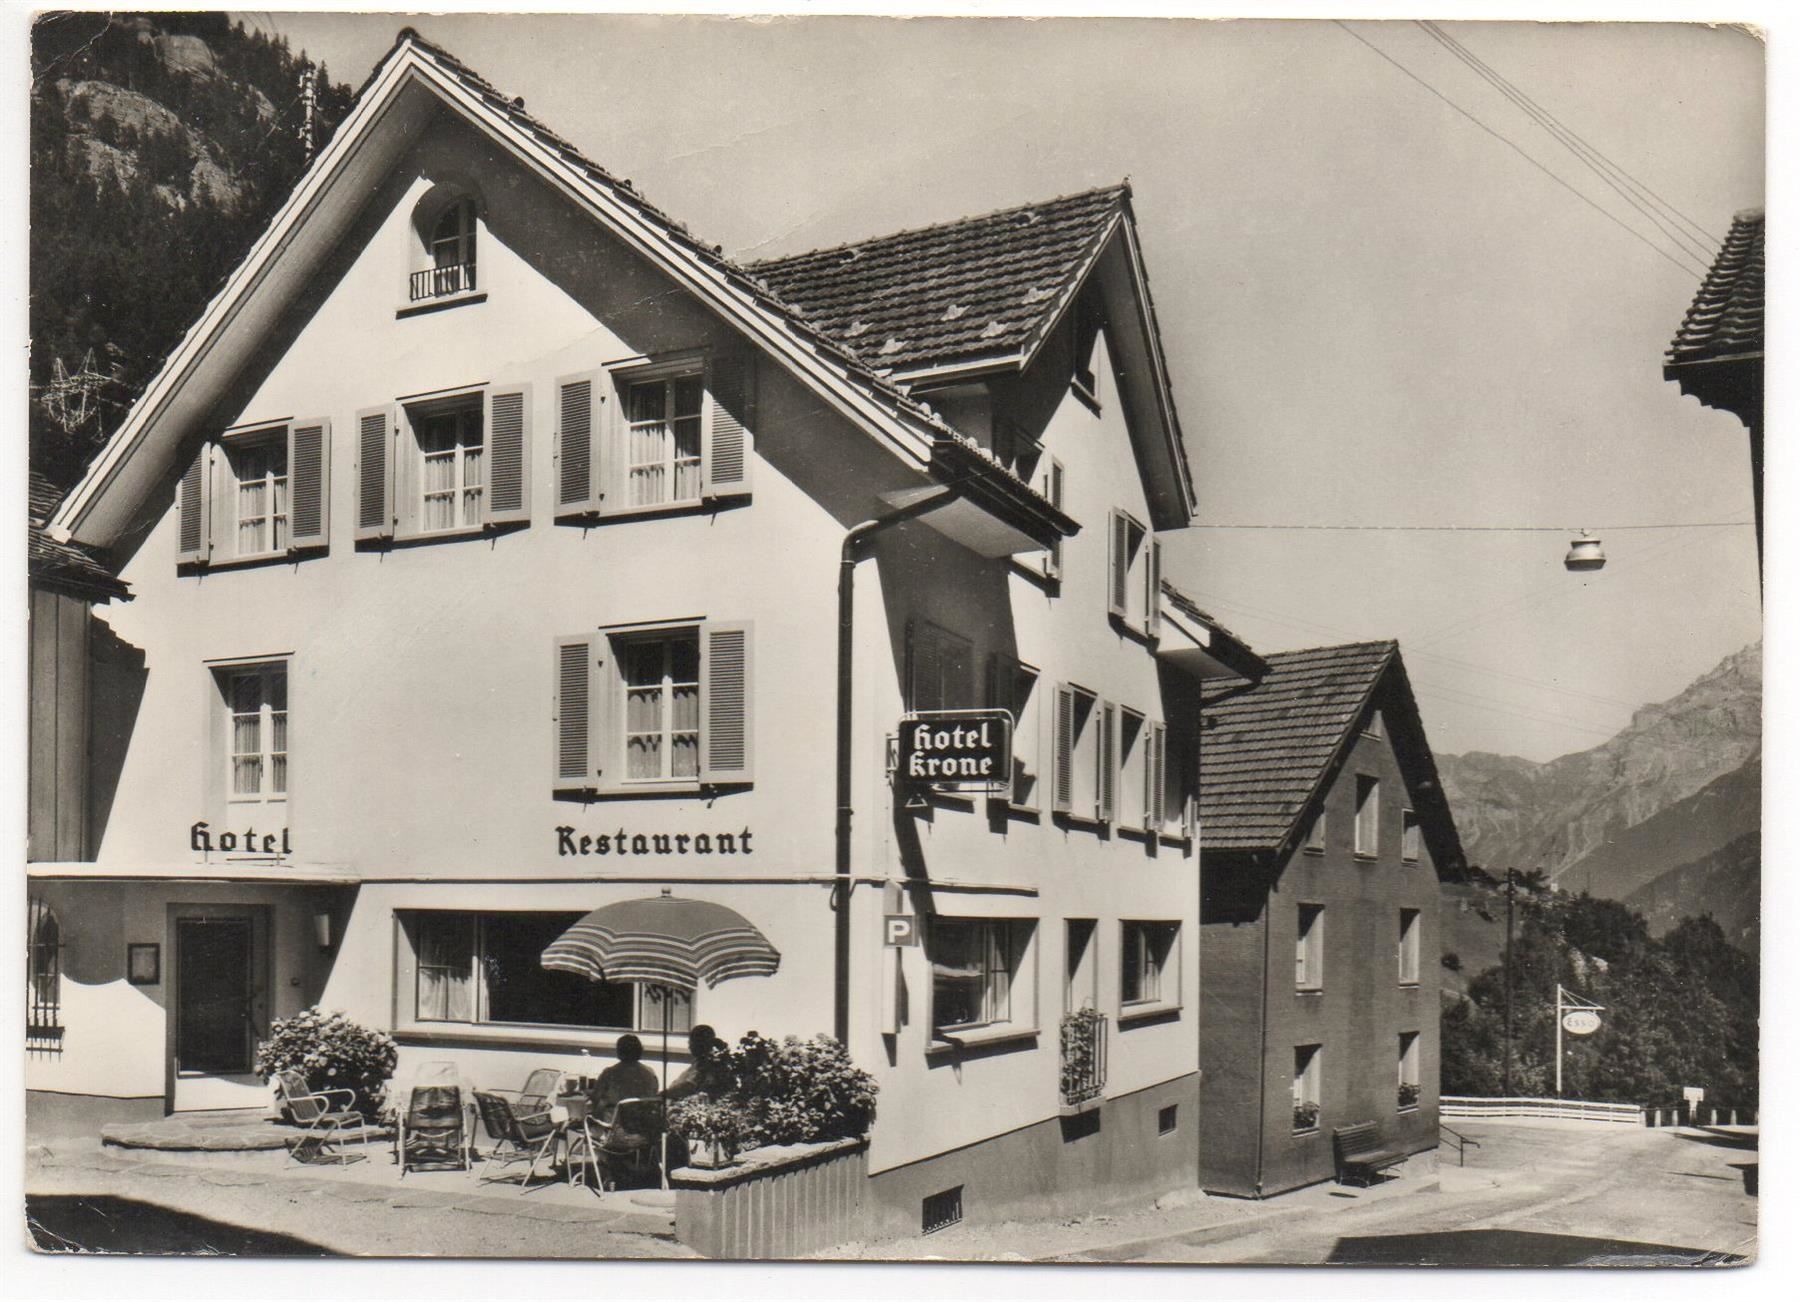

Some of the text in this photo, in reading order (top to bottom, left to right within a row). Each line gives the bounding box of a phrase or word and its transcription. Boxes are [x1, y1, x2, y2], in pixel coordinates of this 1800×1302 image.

[191, 821, 293, 854] Hotel
[555, 825, 753, 857] Restaurant
[888, 920, 910, 944] P
